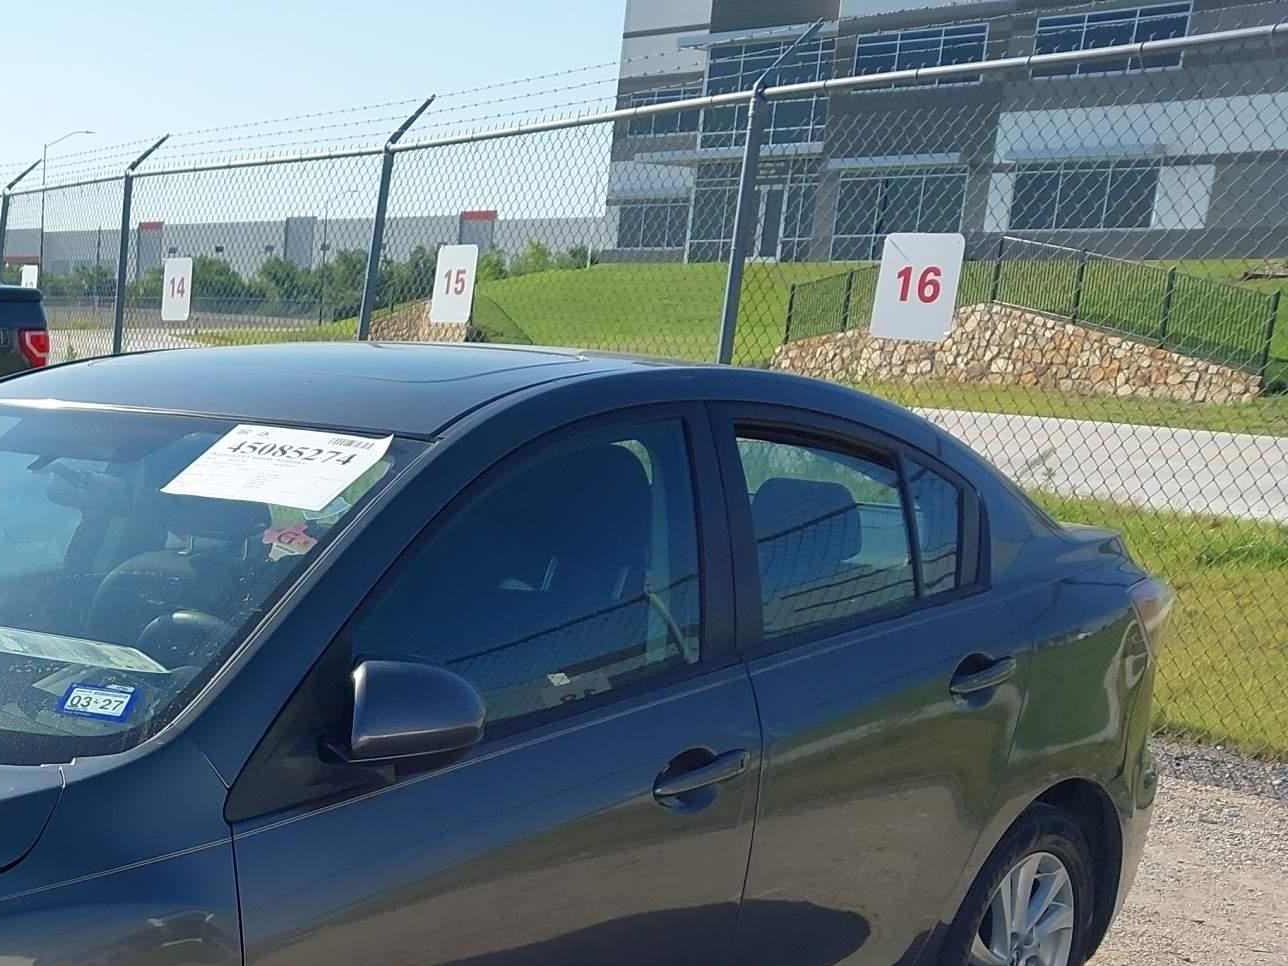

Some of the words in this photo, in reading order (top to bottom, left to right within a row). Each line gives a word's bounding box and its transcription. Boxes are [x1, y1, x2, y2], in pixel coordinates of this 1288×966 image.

[169, 276, 185, 298] 14
[445, 268, 467, 296] 15
[897, 266, 941, 304] 16
[227, 440, 358, 466] 45085274
